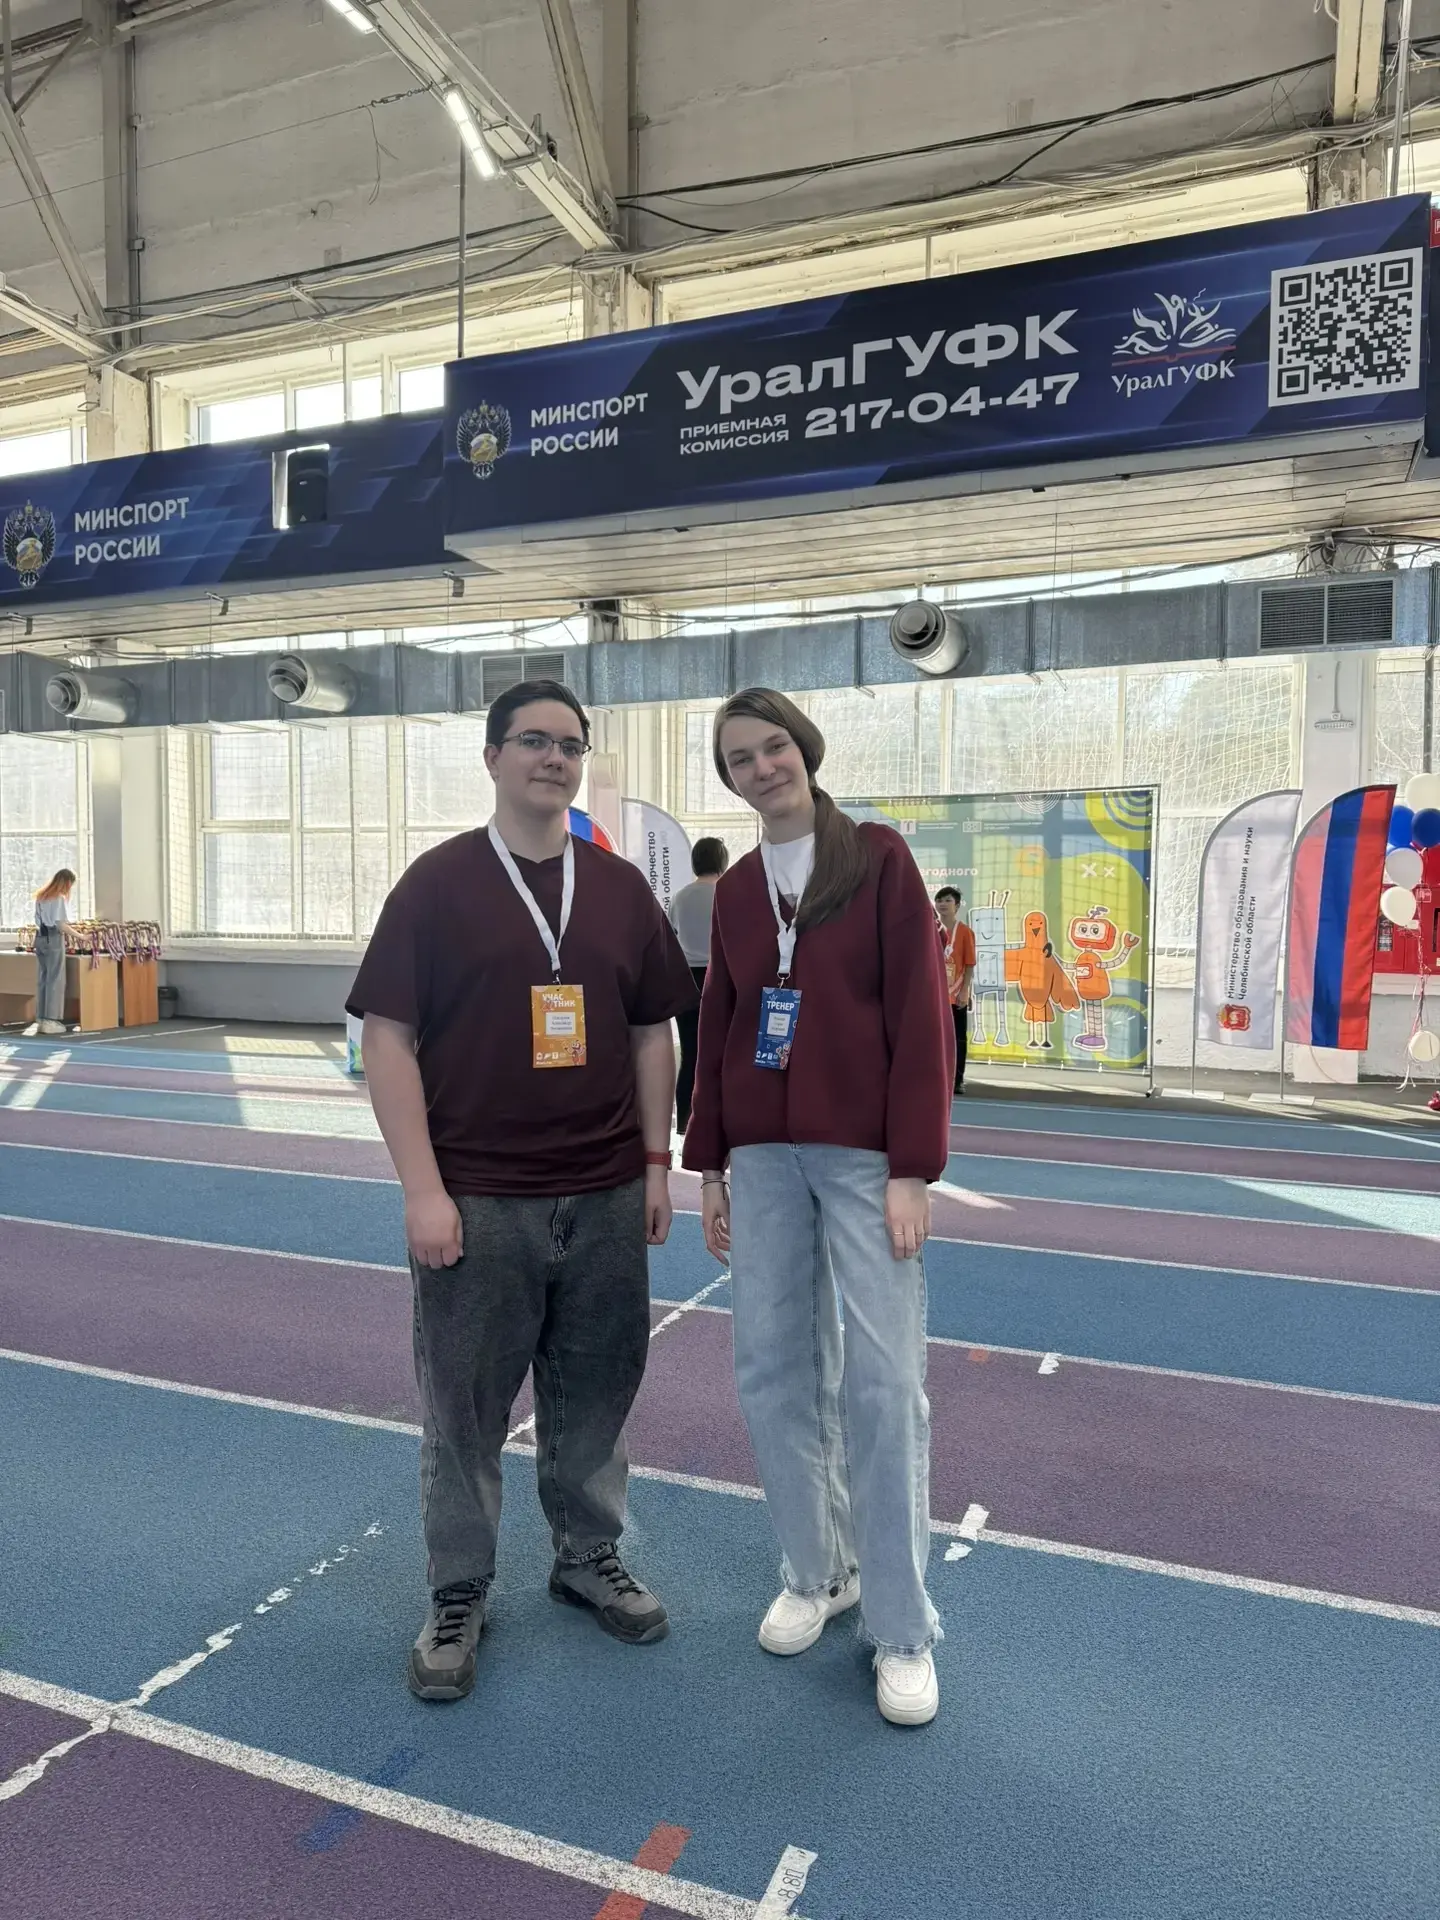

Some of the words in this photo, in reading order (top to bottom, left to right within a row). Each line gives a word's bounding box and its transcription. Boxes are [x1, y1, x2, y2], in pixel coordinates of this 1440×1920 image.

[676, 308, 1080, 415] УралГУФК
[1111, 358, 1236, 398] УралГУФК
[530, 393, 648, 428] МИНСПОРТ
[804, 372, 1081, 439] 217-04-47
[530, 426, 619, 457] РОССИИ
[680, 413, 787, 440] ПРИЕМНАЯ
[680, 429, 790, 455] КОМИССИЯ
[74, 497, 190, 533] МИНСПОРТ
[74, 534, 161, 565] РОССИИ
[647, 831, 659, 896] ворчество
[661, 846, 671, 894] области
[919, 867, 979, 878] егодного
[1227, 931, 1241, 999] Министерство
[1234, 865, 1248, 930] образования
[1243, 826, 1254, 856] науки
[1237, 937, 1253, 1000] Челябинской
[1245, 895, 1257, 934] области
[766, 1000, 795, 1012] ТРЕНЕР
